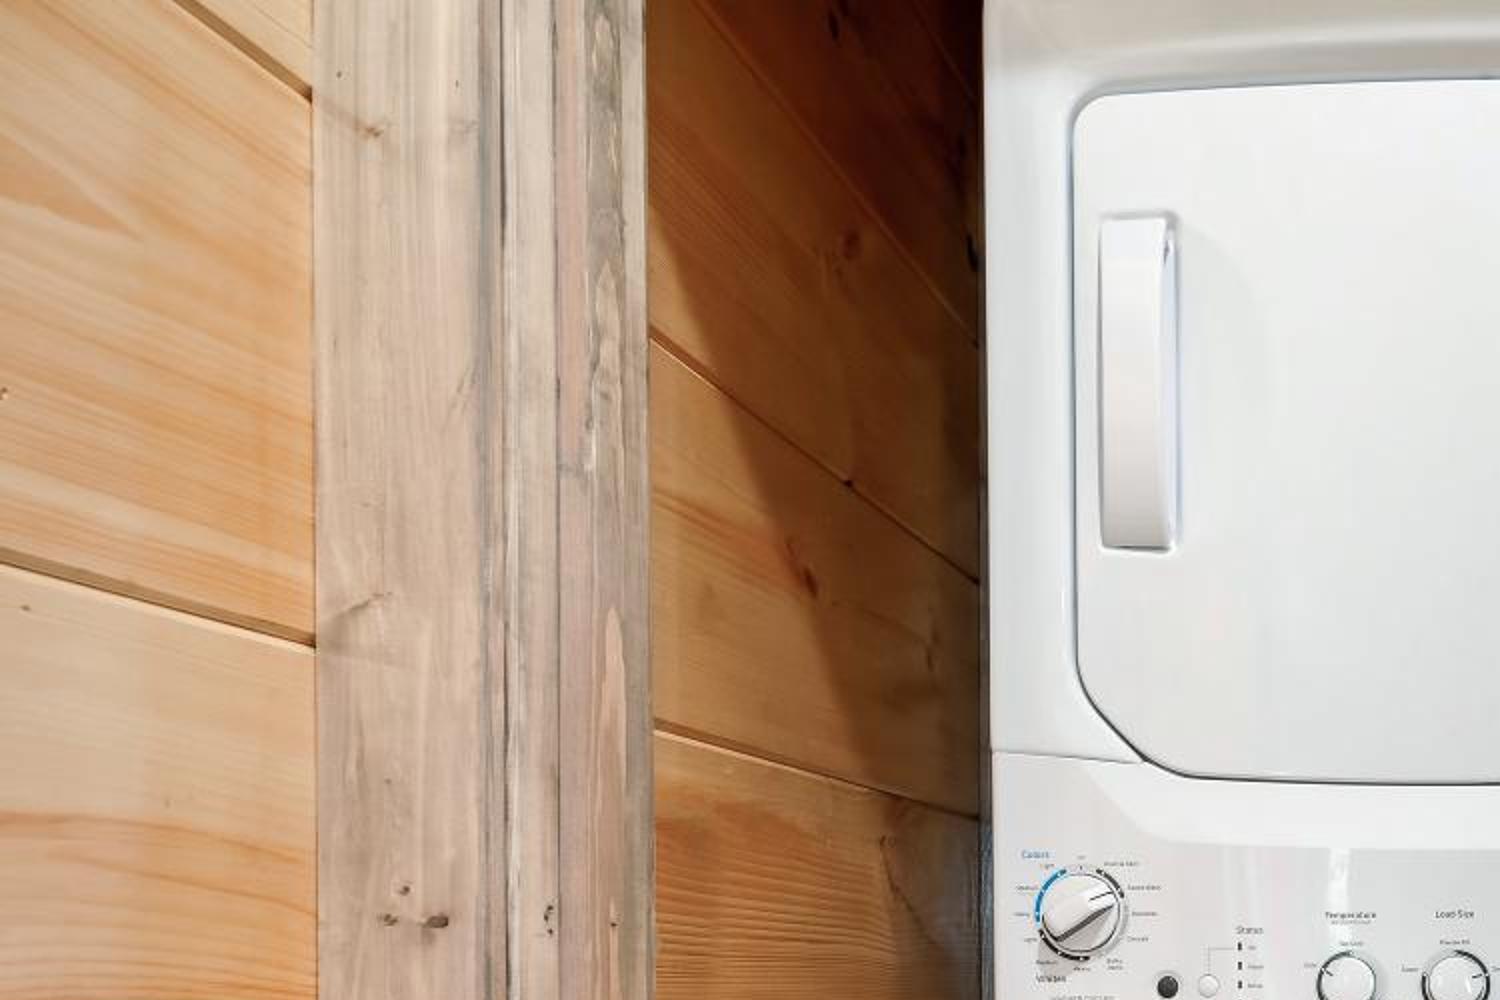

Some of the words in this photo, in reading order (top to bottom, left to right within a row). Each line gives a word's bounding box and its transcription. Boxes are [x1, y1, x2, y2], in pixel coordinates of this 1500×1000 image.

[1325, 911, 1377, 921] Temperature
[1435, 910, 1456, 919] Load
[1458, 909, 1475, 919] Size
